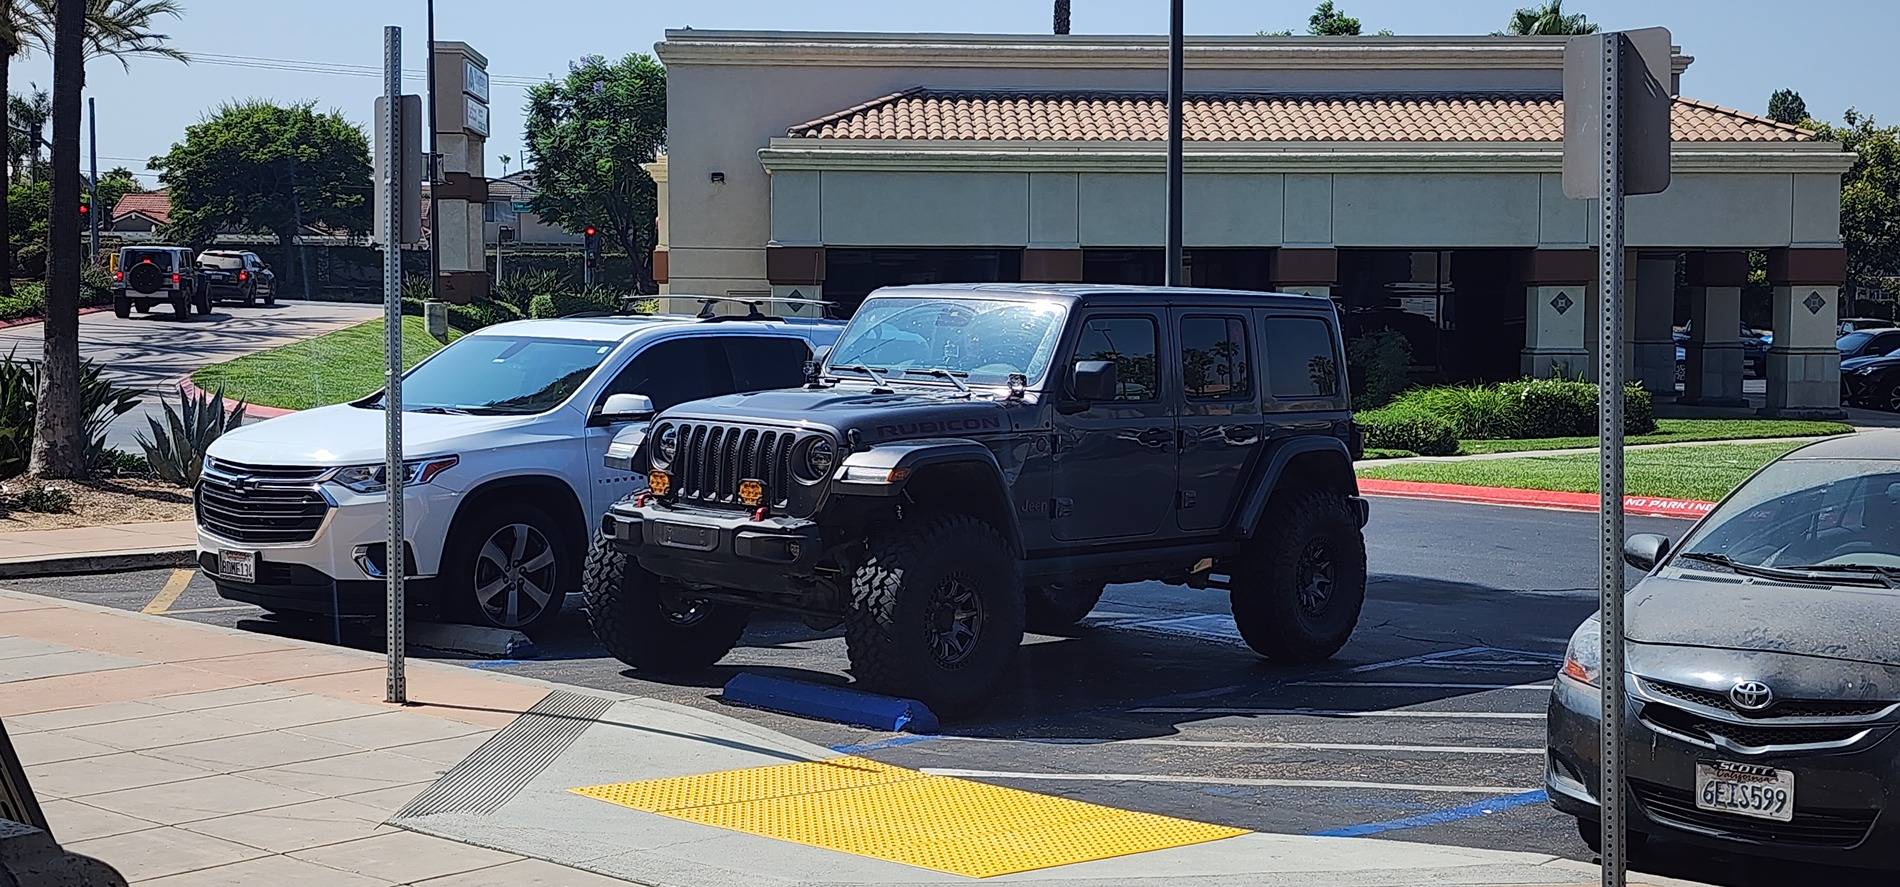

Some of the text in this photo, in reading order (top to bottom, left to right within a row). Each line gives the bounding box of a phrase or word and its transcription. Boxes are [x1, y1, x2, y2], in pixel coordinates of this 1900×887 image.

[878, 416, 1000, 437] RUBICON
[1021, 499, 1048, 514] Jeep
[1625, 498, 1715, 511] NO PARKING
[1719, 761, 1769, 775] SCOTT
[1704, 780, 1787, 813] 6EIS599
